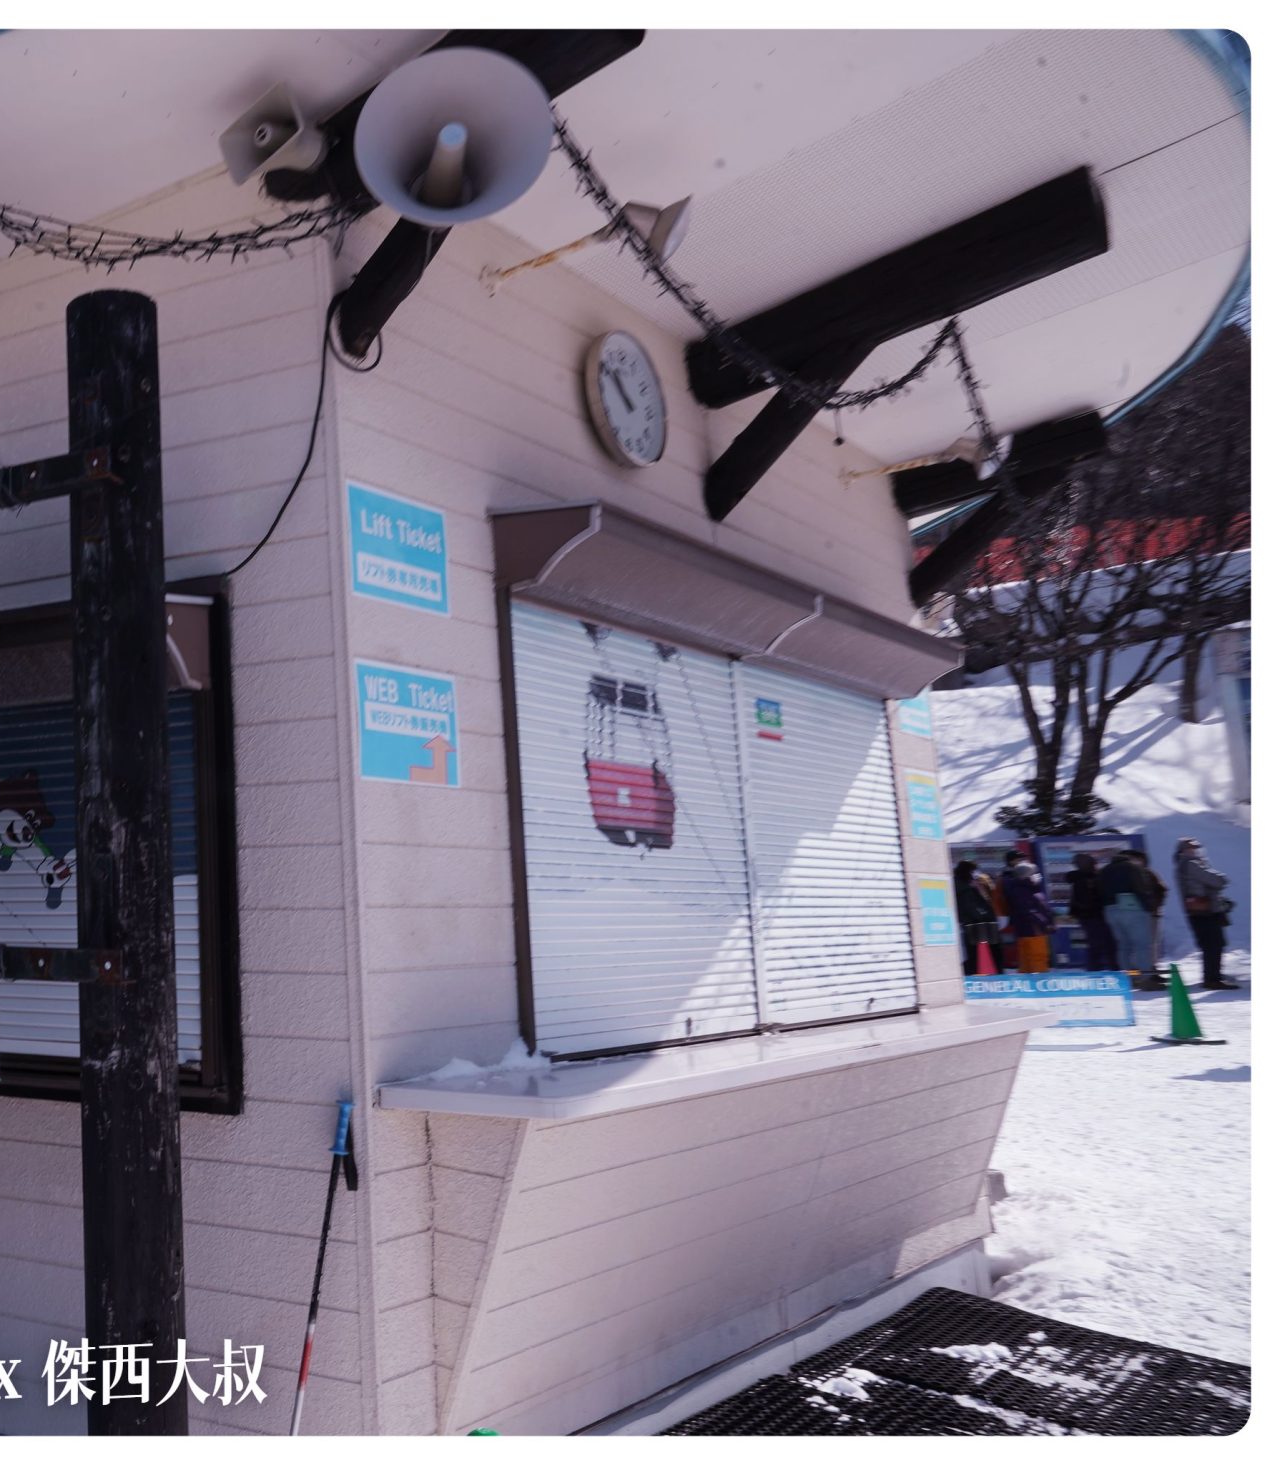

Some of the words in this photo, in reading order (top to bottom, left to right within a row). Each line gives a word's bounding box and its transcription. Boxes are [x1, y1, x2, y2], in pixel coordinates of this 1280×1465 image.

[361, 508, 394, 540] Lift
[396, 519, 442, 554] Ticket
[364, 674, 399, 704] WEB
[408, 682, 455, 712] Ticket
[1035, 975, 1120, 992] COUNTER
